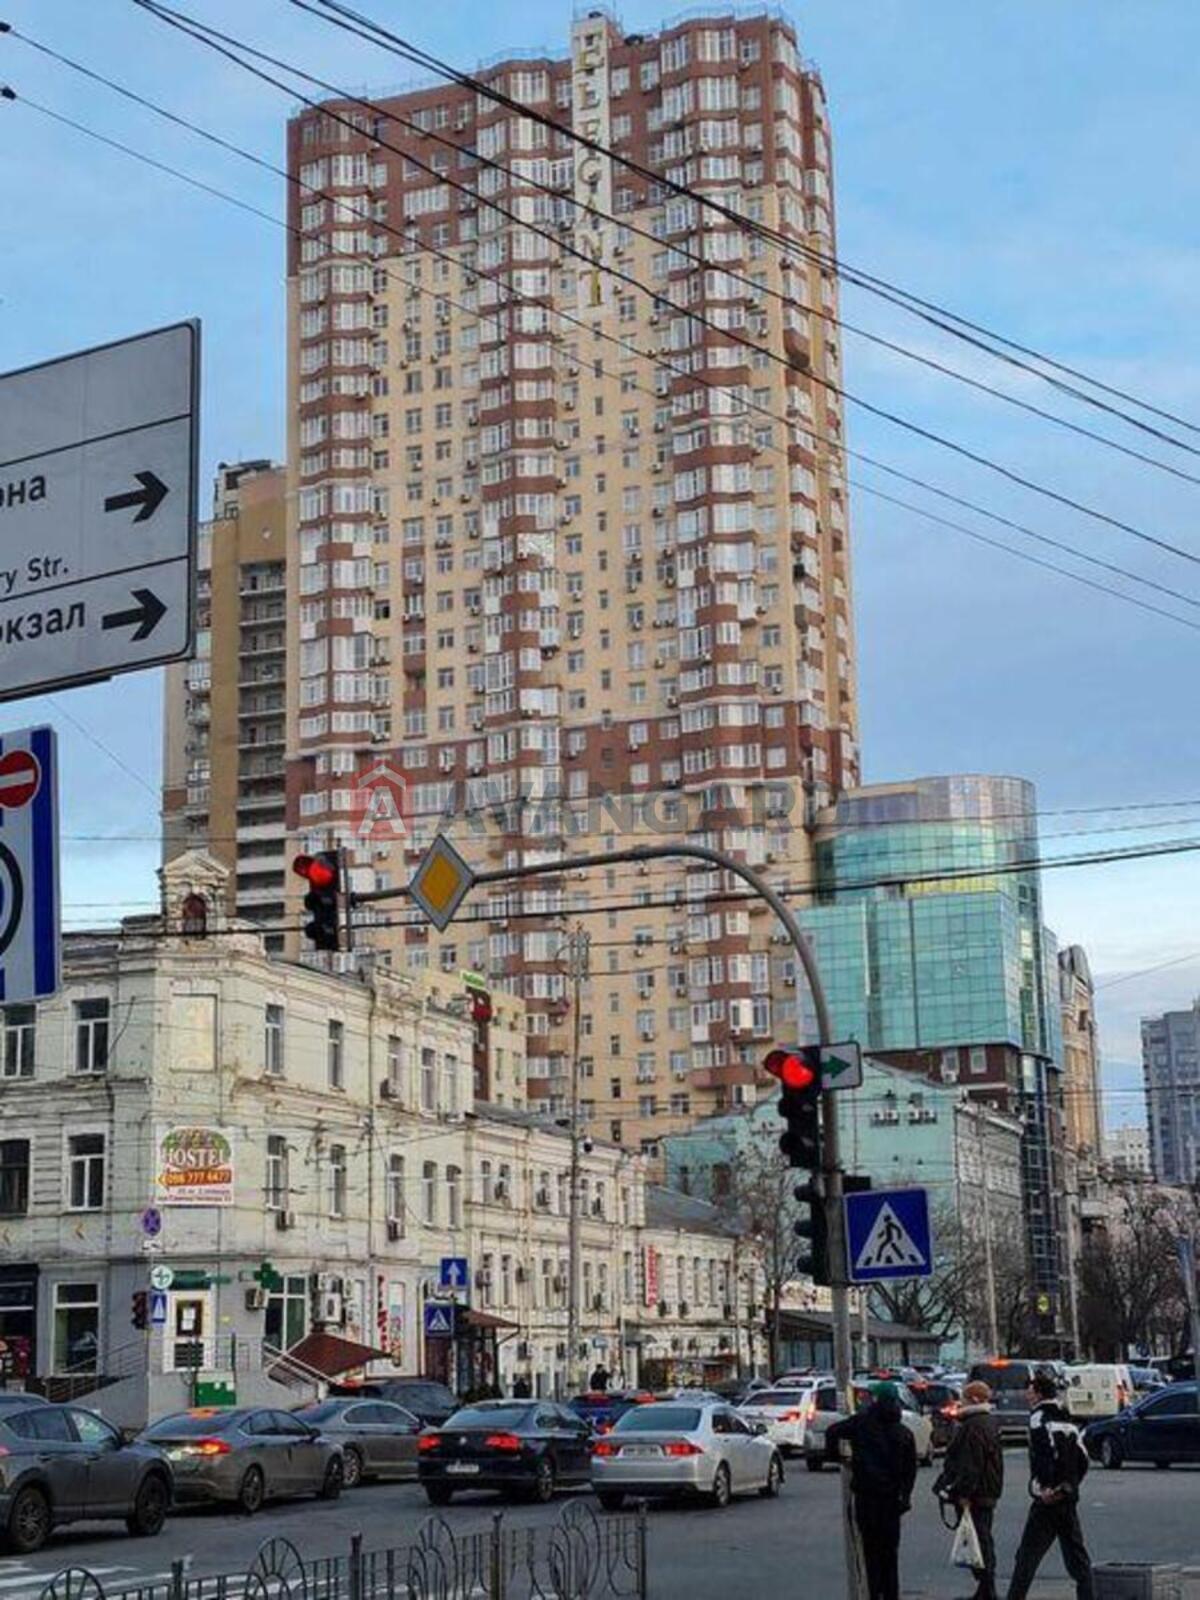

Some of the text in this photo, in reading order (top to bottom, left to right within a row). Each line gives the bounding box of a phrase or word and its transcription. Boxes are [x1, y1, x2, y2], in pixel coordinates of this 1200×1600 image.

[0, 475, 46, 508] на
[27, 556, 69, 582] Str.
[0, 601, 86, 645] кзал
[161, 1147, 225, 1168] HOSTEL
